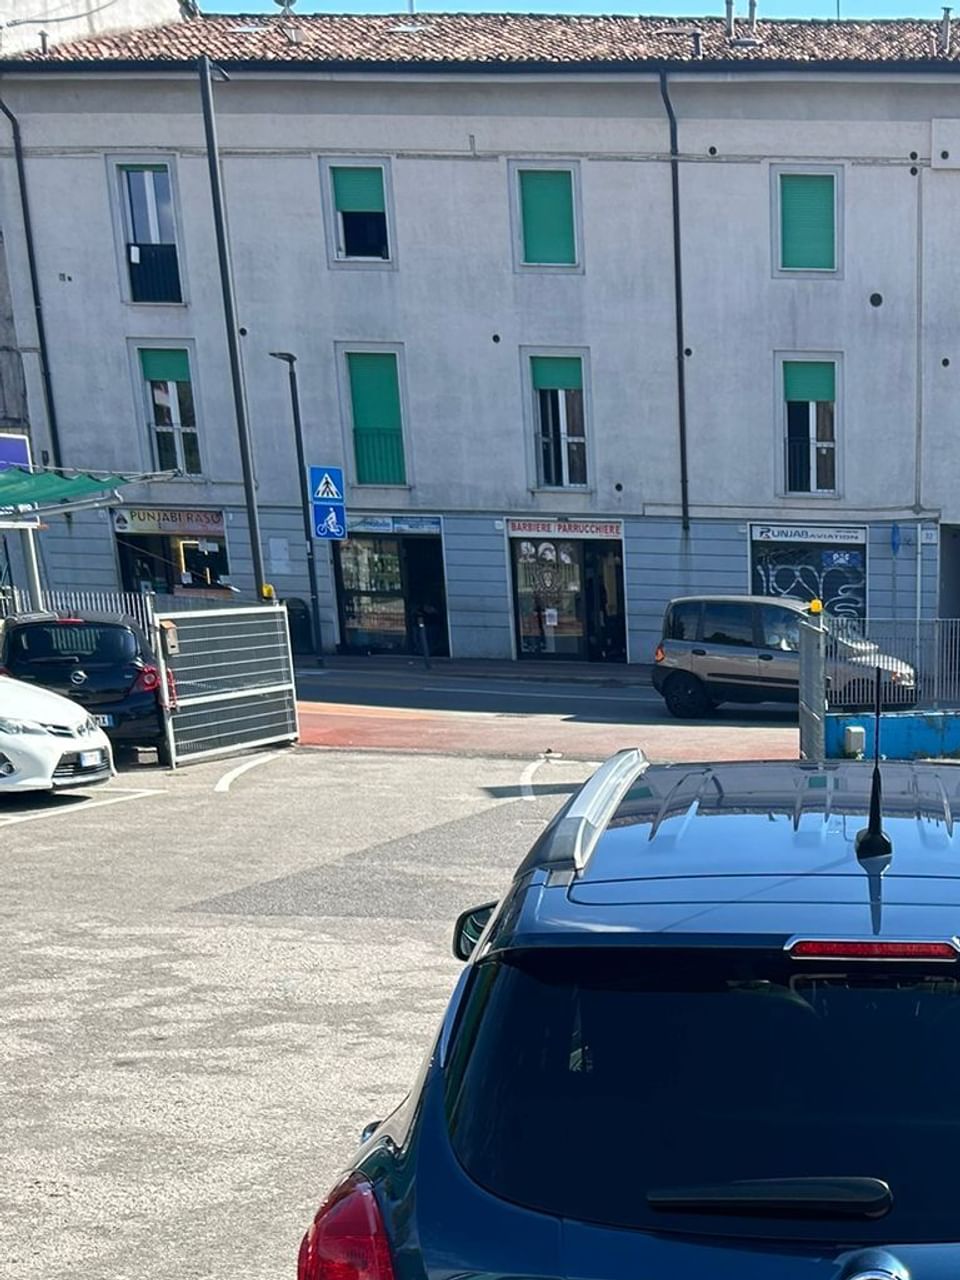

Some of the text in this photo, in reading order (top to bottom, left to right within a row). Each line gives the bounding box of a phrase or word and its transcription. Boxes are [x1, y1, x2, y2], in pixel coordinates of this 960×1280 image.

[130, 511, 182, 522] PUNJABI
[511, 523, 621, 534] BARBIERE PARRUCCHIERE
